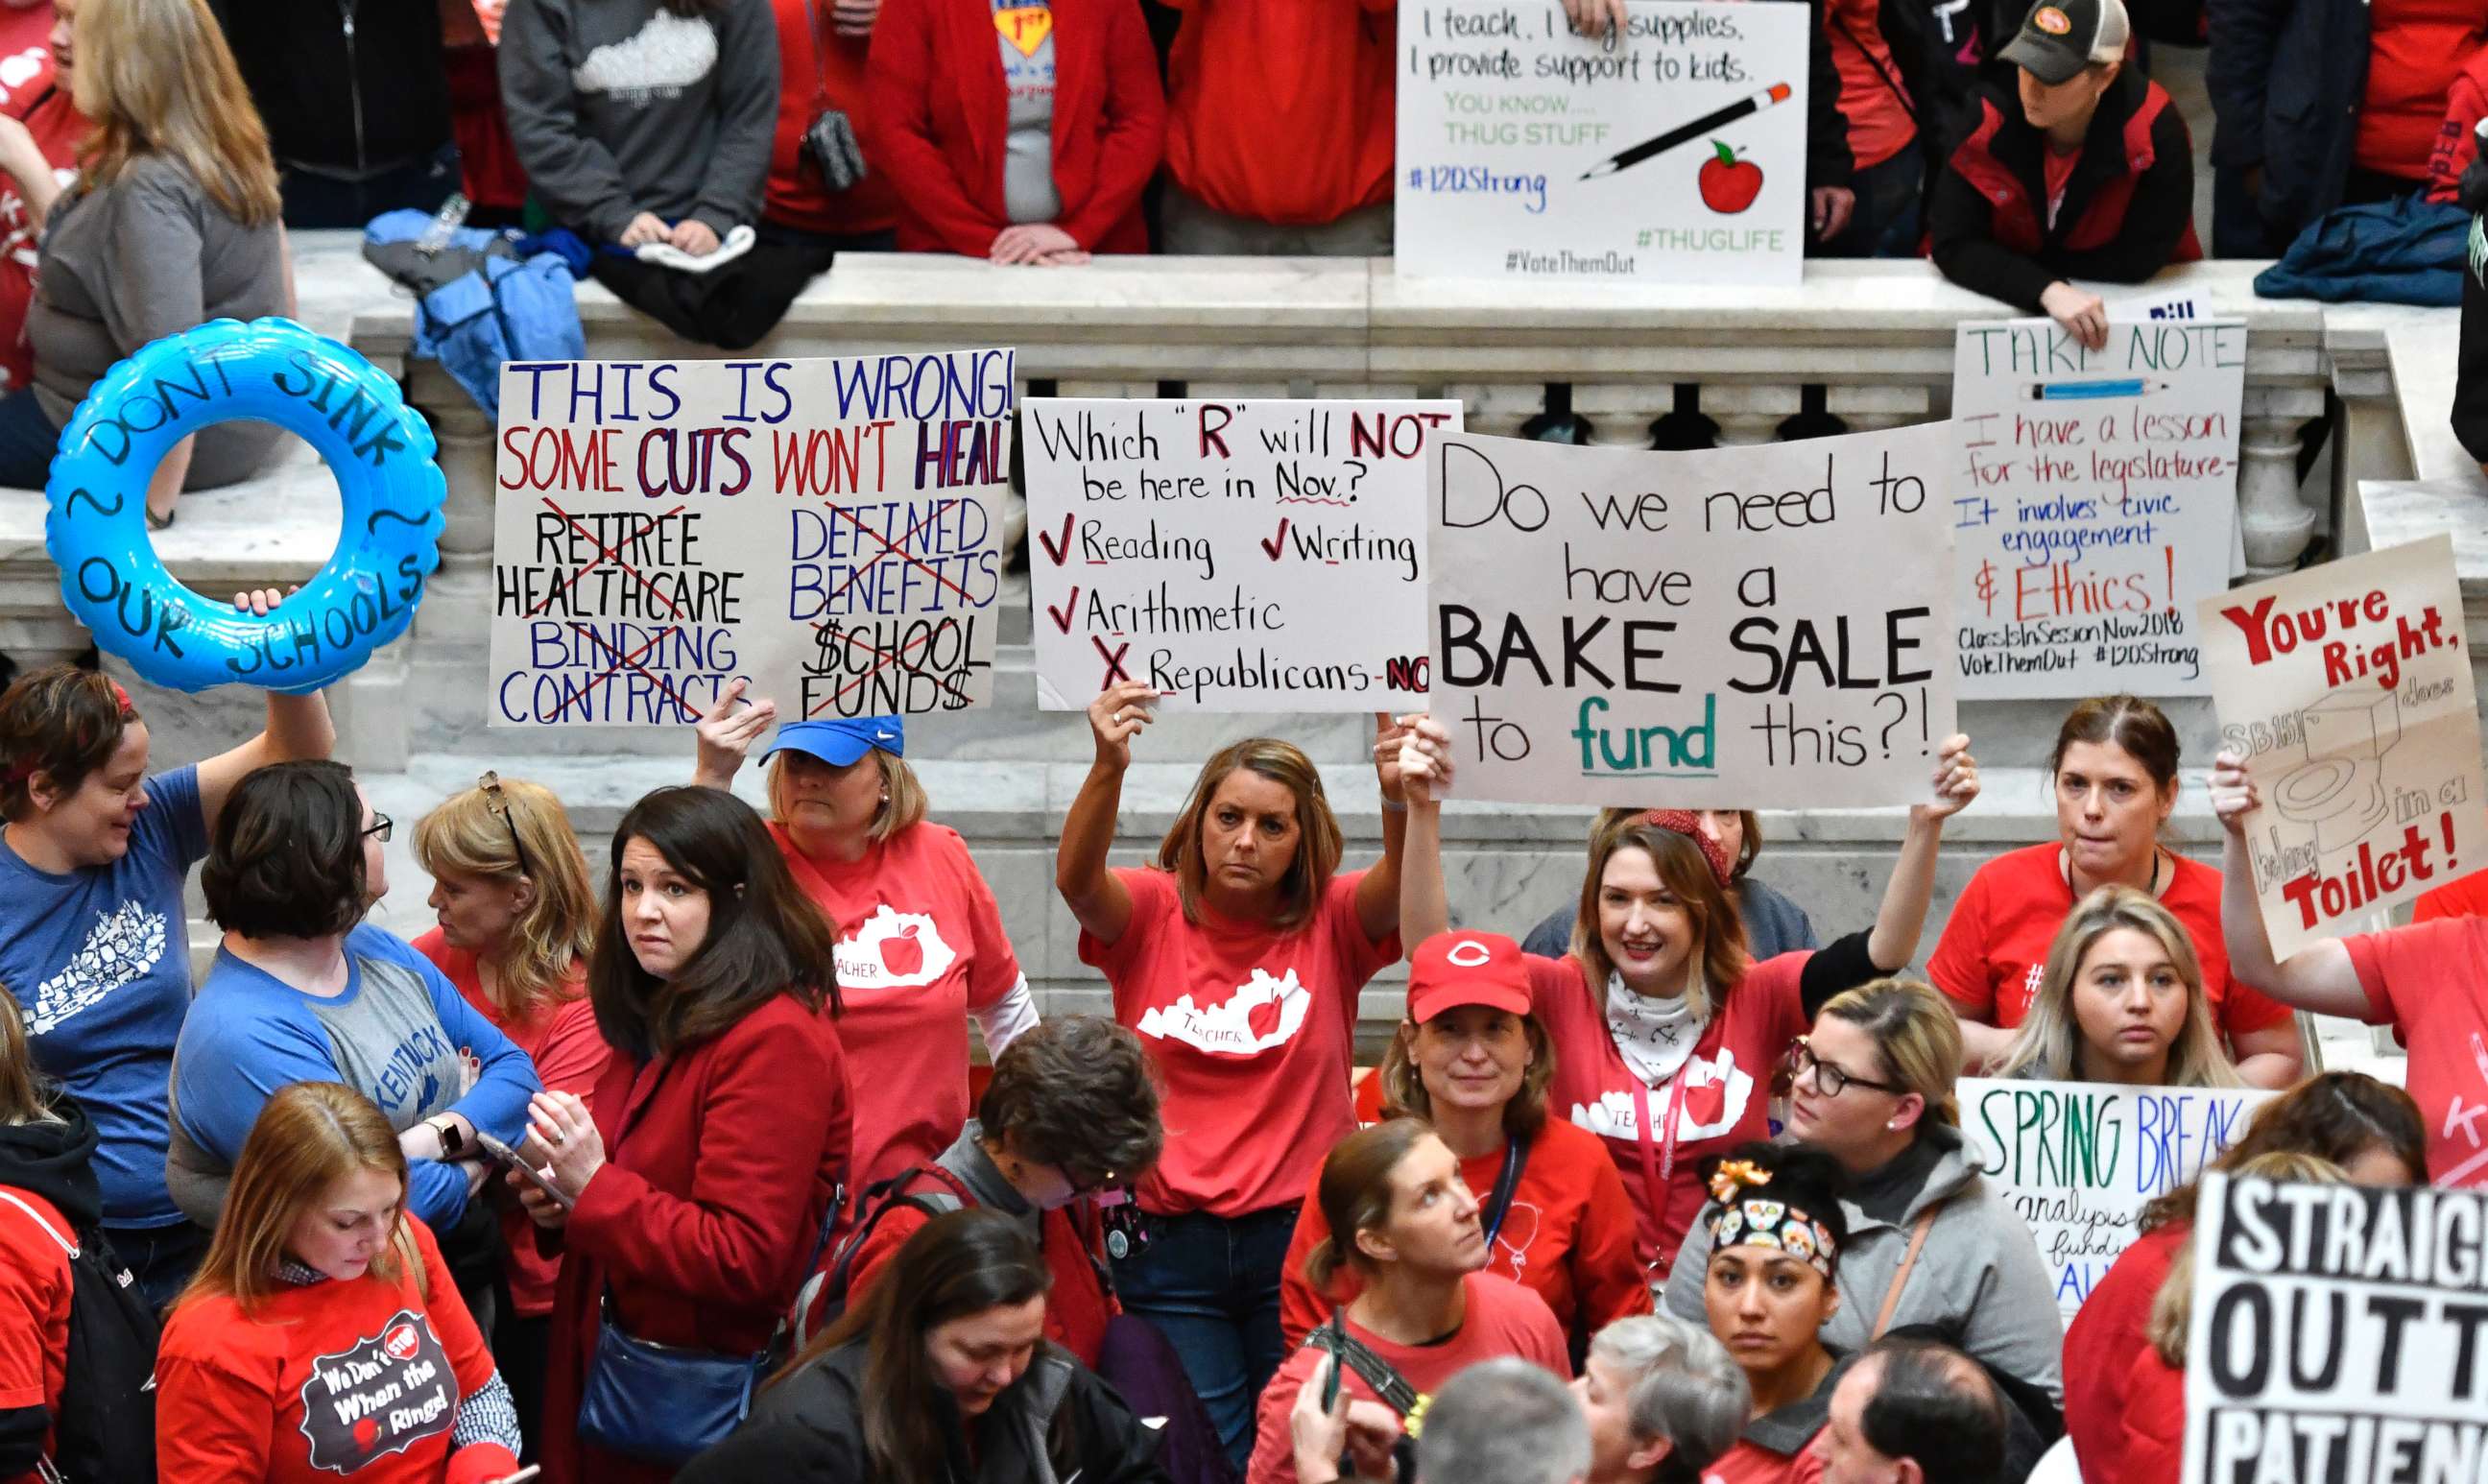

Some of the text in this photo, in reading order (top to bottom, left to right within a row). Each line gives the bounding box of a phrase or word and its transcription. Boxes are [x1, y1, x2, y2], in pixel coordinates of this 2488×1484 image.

[1423, 9, 1431, 37] I
[1545, 8, 1554, 38] I
[1627, 9, 1744, 44] supplies.
[1410, 45, 1754, 85] I provide support to kids.
[1444, 93, 1494, 115] YOU
[1445, 122, 1611, 146] THUG STUFF
[1506, 251, 1636, 275] #VoteThemOut
[1638, 229, 1785, 252] #THUGLIFE
[2128, 323, 2247, 371] NOTE
[273, 348, 406, 468] SINK
[509, 349, 1015, 425] THIS IS WRONG!
[1034, 407, 1160, 462] Which
[1260, 408, 1329, 458] will
[1963, 404, 2227, 448] I have a lesson
[499, 419, 1009, 497] SOME CUTS WON'T HEAL
[1083, 465, 1127, 501] be
[1140, 467, 1210, 501] here
[1225, 467, 1256, 498] in
[1963, 450, 2015, 489] for
[2027, 452, 2080, 483] the
[1443, 443, 1926, 532] Do we need to
[1953, 494, 2182, 528] It involves civic
[536, 513, 702, 567] RETIREE
[791, 497, 989, 561] DEFINED
[1083, 519, 1419, 582] Reading Writing
[2002, 521, 2160, 567] engagement
[497, 564, 744, 624] HEALTHCARE
[789, 549, 999, 621] BENEFITS
[1565, 541, 1777, 608] have a
[79, 556, 192, 660] OUR
[226, 553, 422, 675] SCHOOLS
[1088, 581, 1285, 632] Arithmetic
[2220, 588, 2389, 666] You're
[531, 620, 738, 671] BINDING
[802, 615, 992, 675] $CHOOL
[1439, 604, 1933, 696] BAKE SALE
[1959, 647, 2079, 678] VoteThemOut
[2323, 606, 2458, 690] Right,
[500, 670, 753, 726] CONTRACTS
[802, 669, 973, 723] FUND$
[2402, 675, 2455, 708] does
[1462, 686, 1929, 771] to fund this?!
[2250, 775, 2468, 896] belong in a
[1980, 1089, 2122, 1189] SPRING
[2046, 1229, 2128, 1268] fundi
[2229, 1176, 2488, 1289] STRAIG
[322, 1326, 416, 1397] We Don't STOP
[333, 1359, 437, 1425] When the
[389, 1383, 449, 1436] Rings!
[2211, 1408, 2488, 1484] PATIEN
